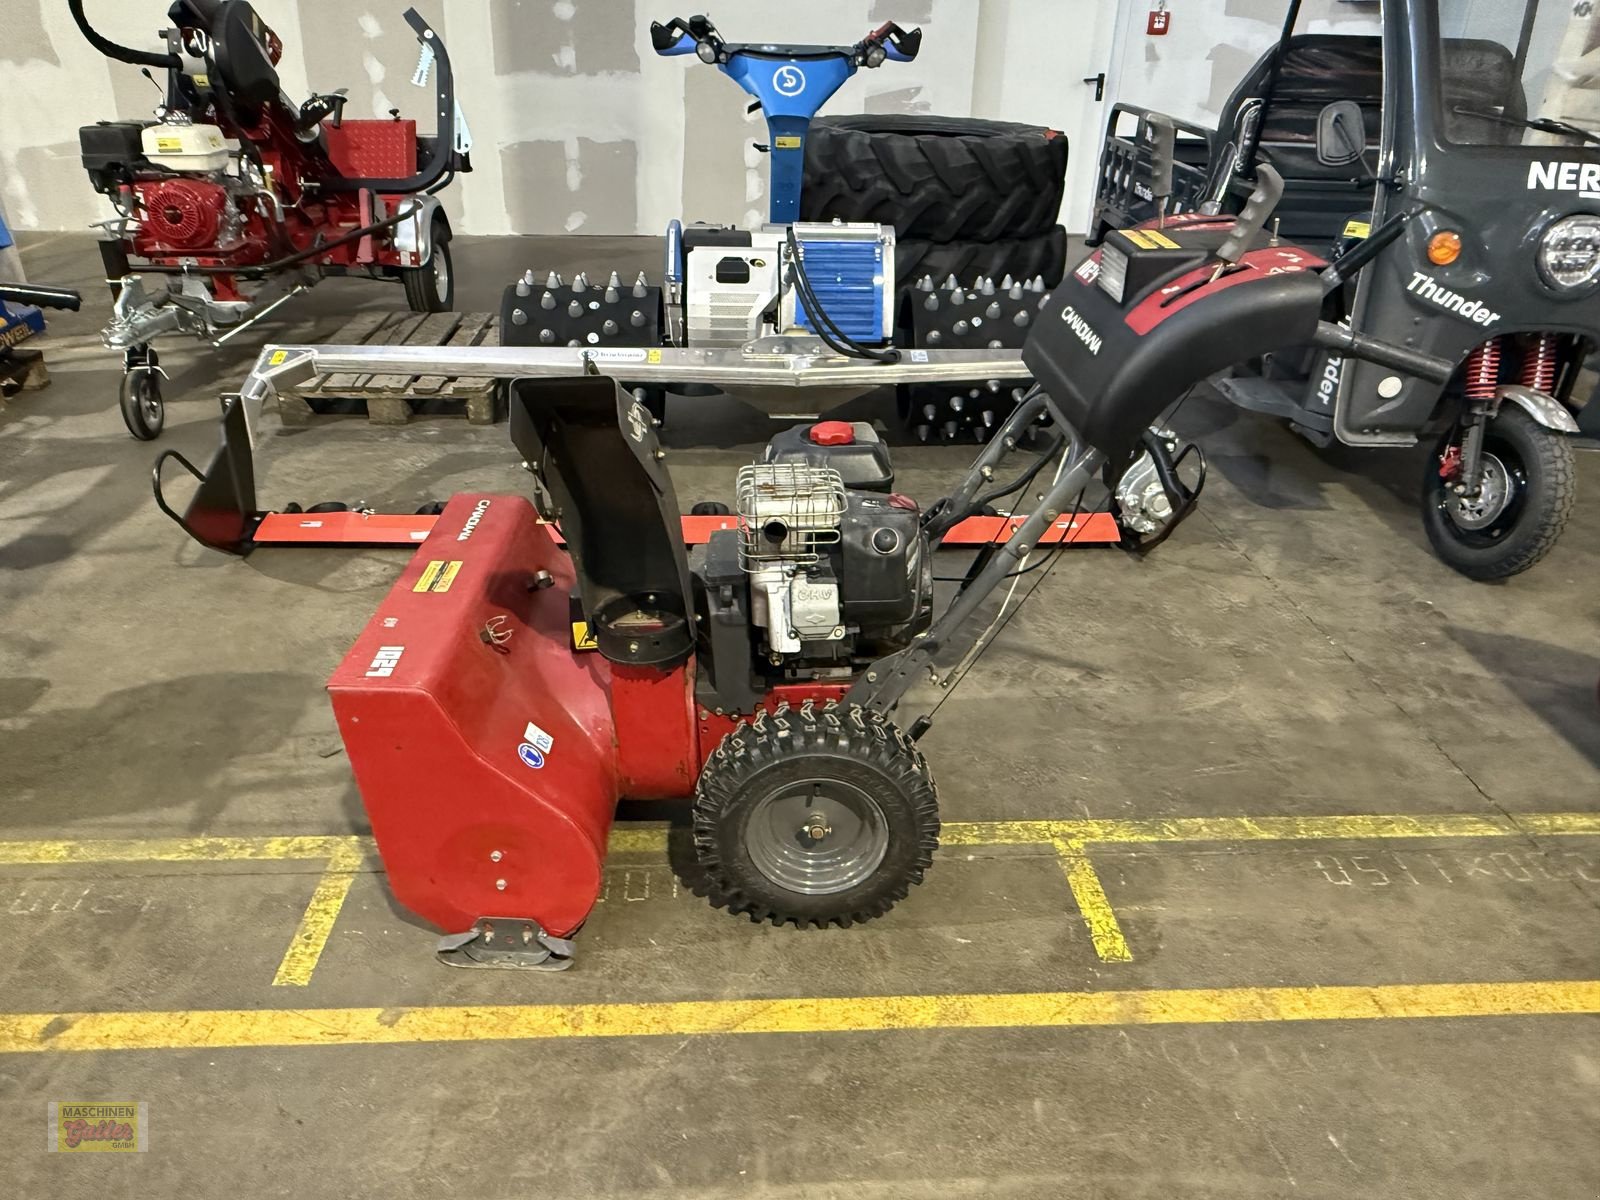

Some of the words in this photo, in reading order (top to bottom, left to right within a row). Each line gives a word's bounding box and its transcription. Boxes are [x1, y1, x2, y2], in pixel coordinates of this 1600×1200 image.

[1406, 271, 1501, 327] Thunder
[1061, 305, 1103, 356] CANADIANA
[456, 499, 491, 541] CANADIANA
